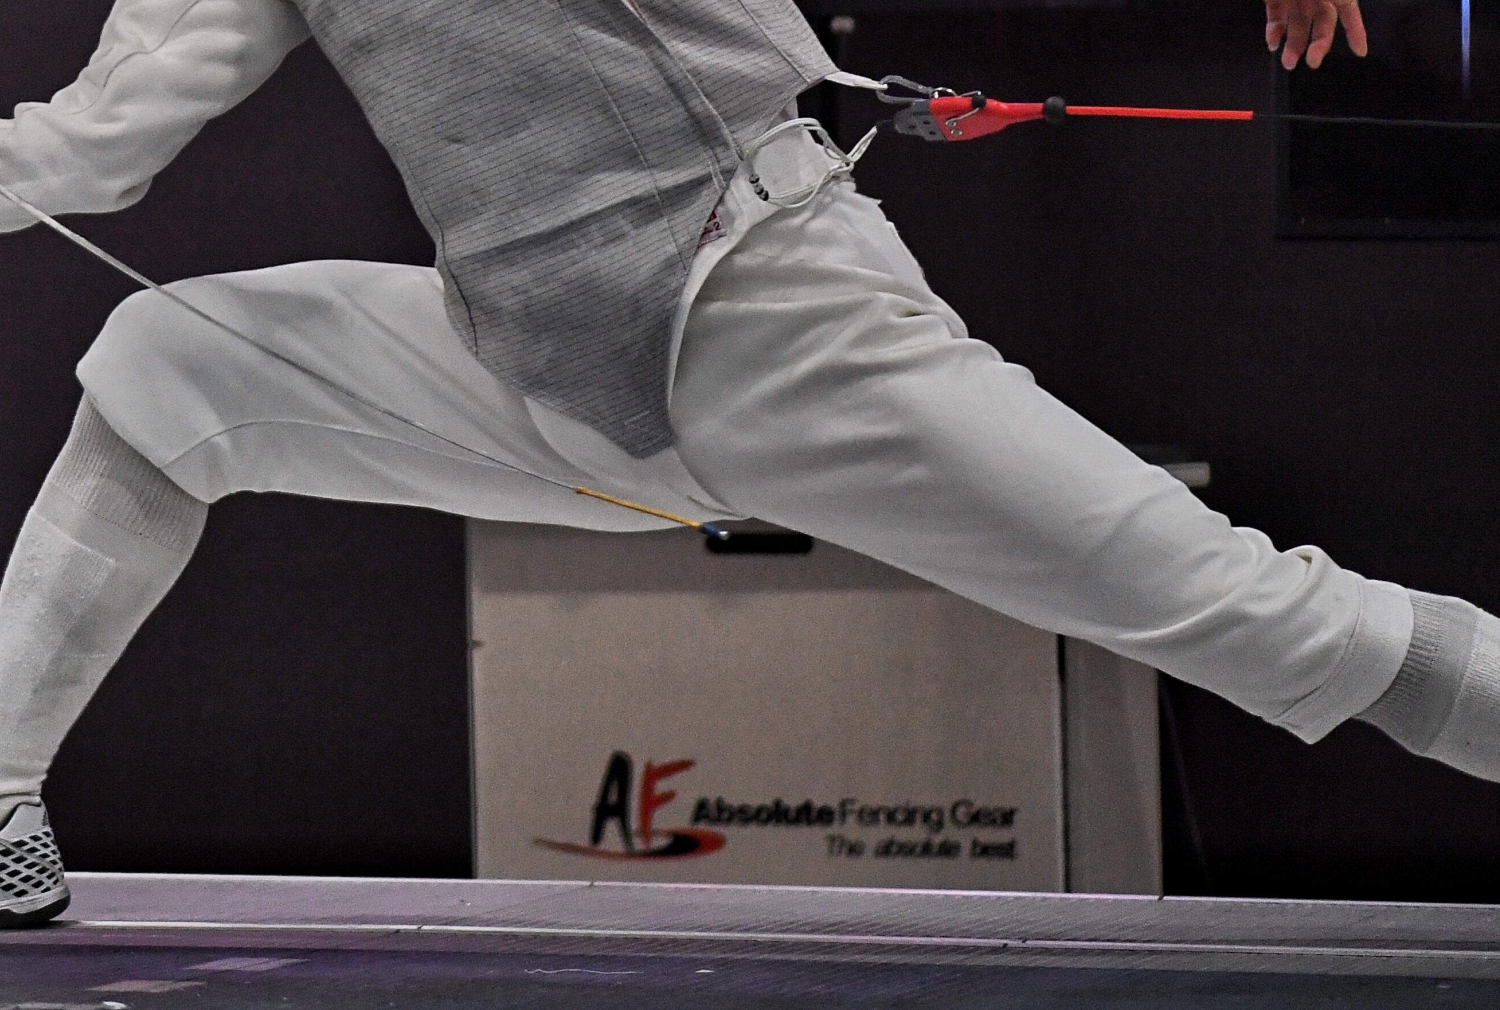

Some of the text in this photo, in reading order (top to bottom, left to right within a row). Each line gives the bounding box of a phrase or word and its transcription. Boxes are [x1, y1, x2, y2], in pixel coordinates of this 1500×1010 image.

[690, 797, 1017, 833] Absolute Fencing Gear
